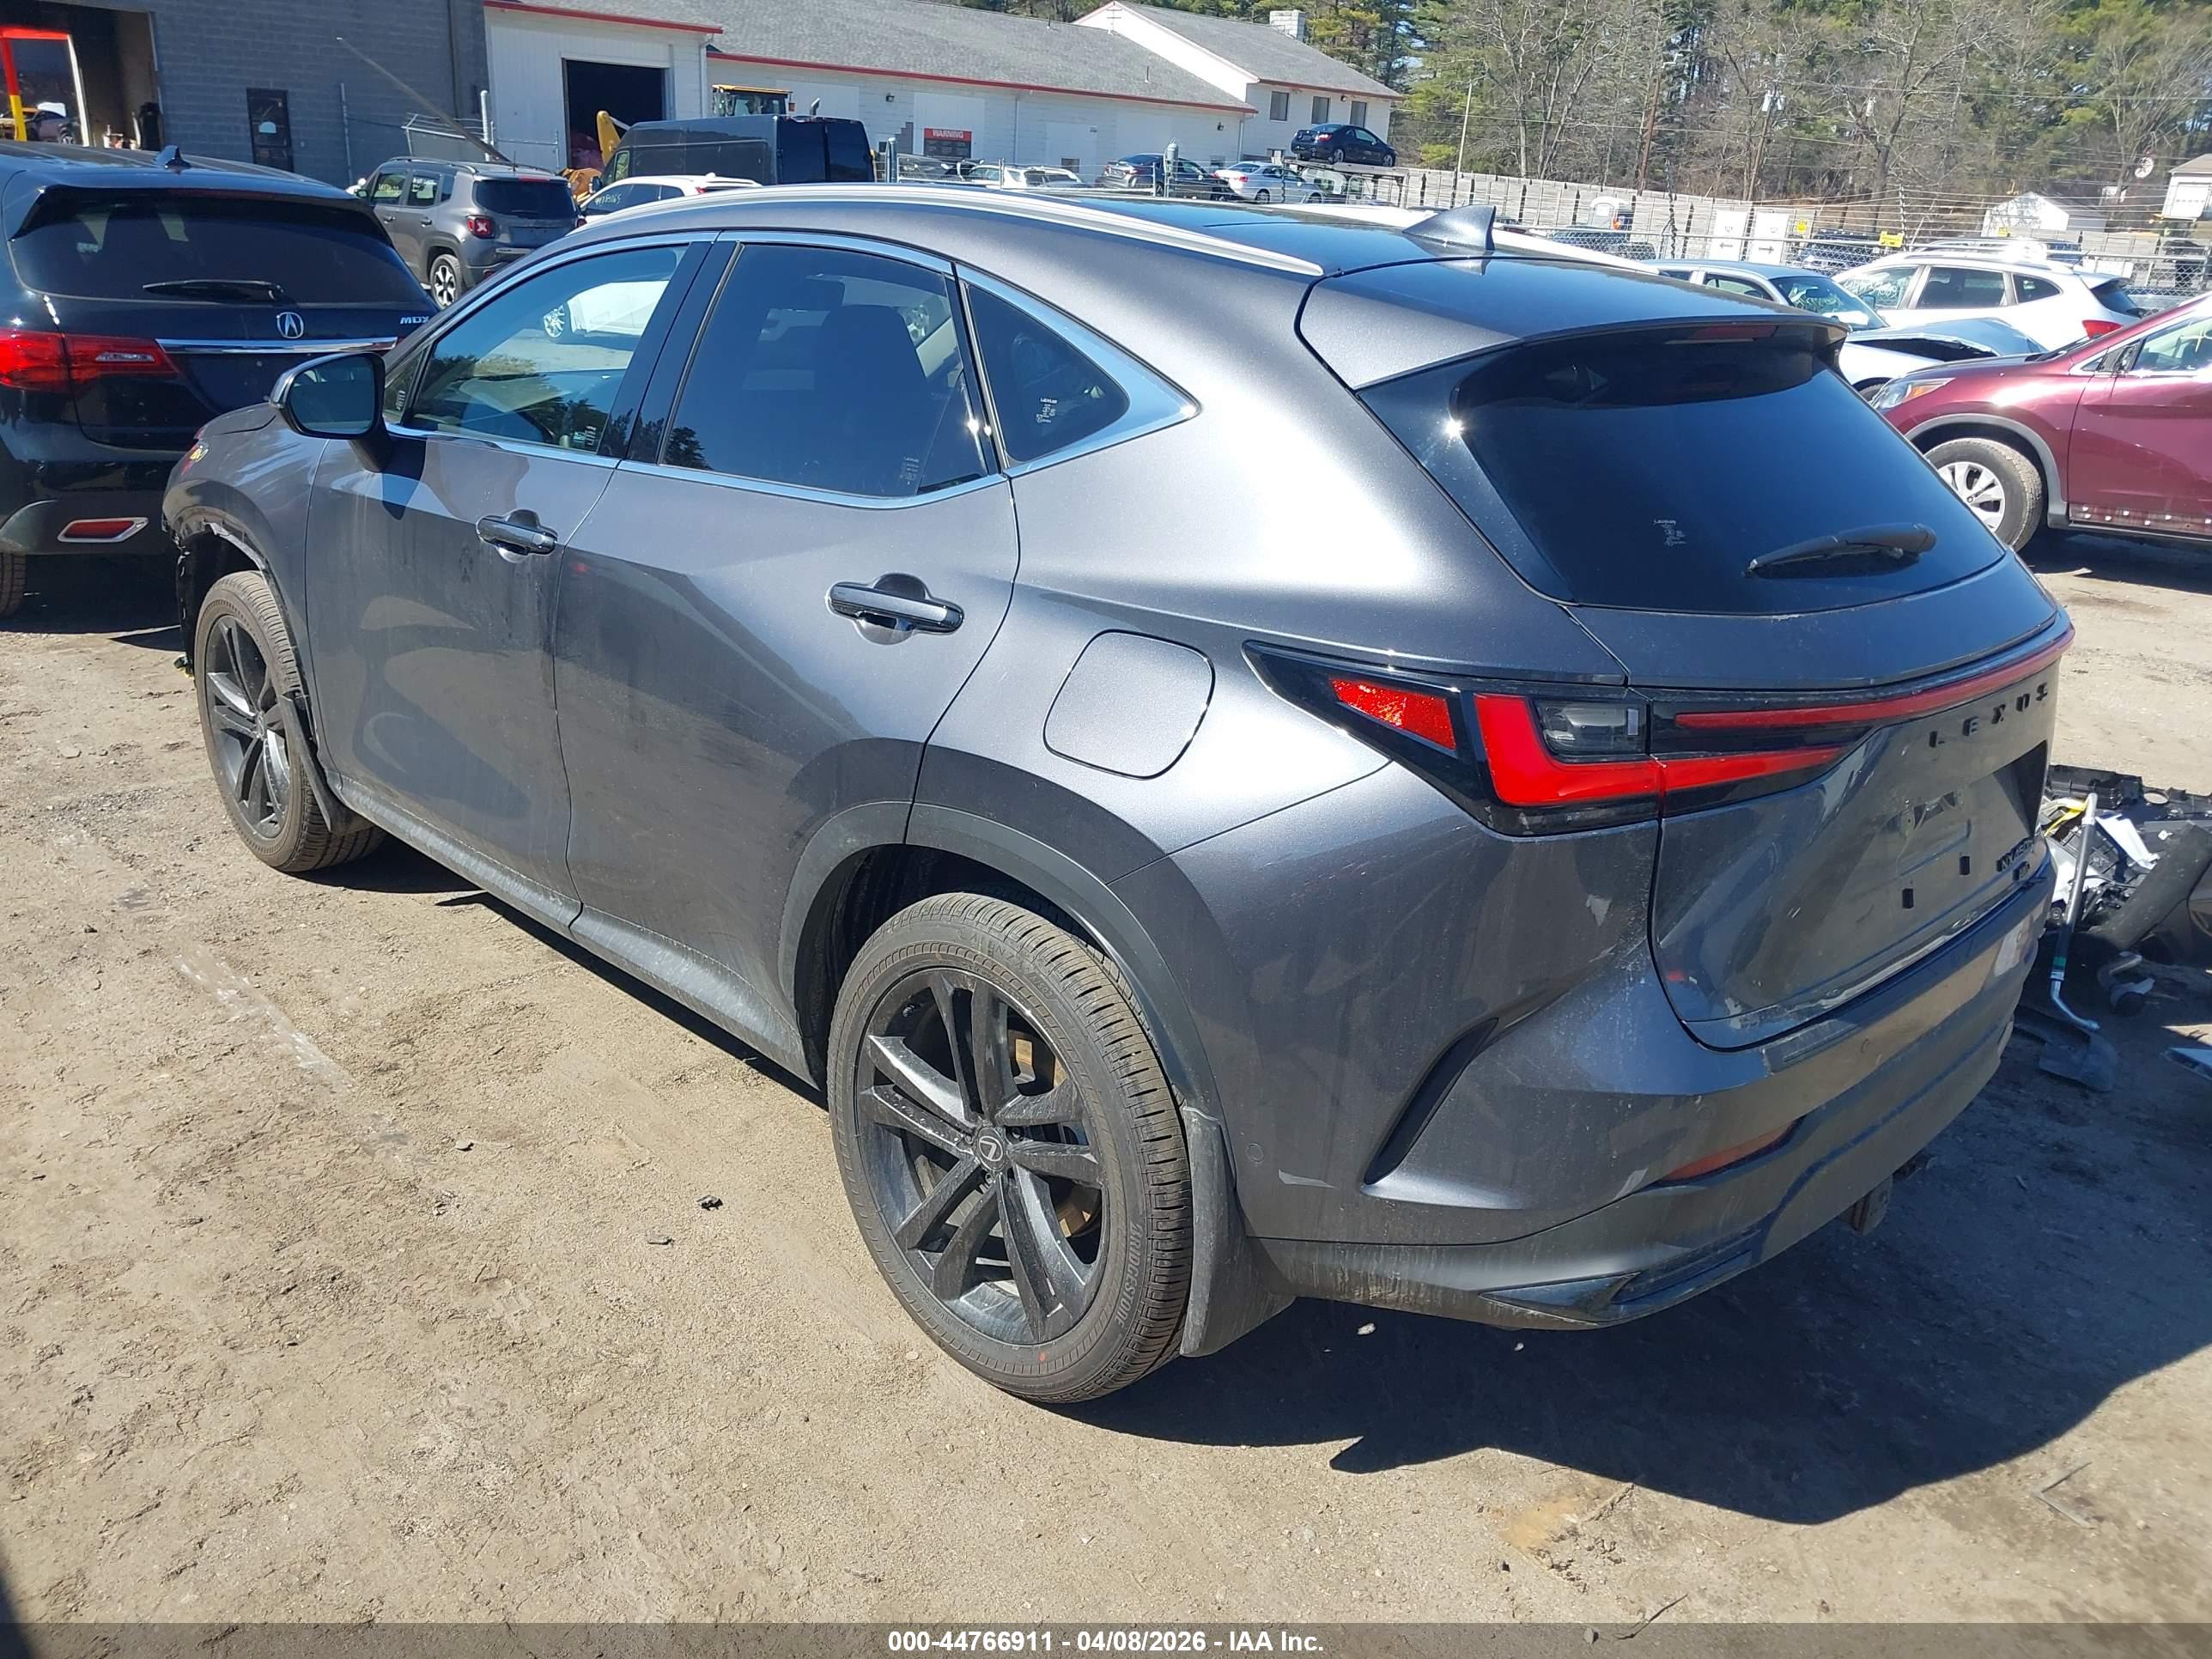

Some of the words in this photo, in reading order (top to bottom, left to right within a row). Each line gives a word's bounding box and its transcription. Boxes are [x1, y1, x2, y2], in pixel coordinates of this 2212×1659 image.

[933, 128, 964, 139] WARNING
[399, 315, 429, 325] MDX
[1928, 681, 2049, 749] LEXUS
[1114, 1219, 1144, 1329] BRIDGESTONE
